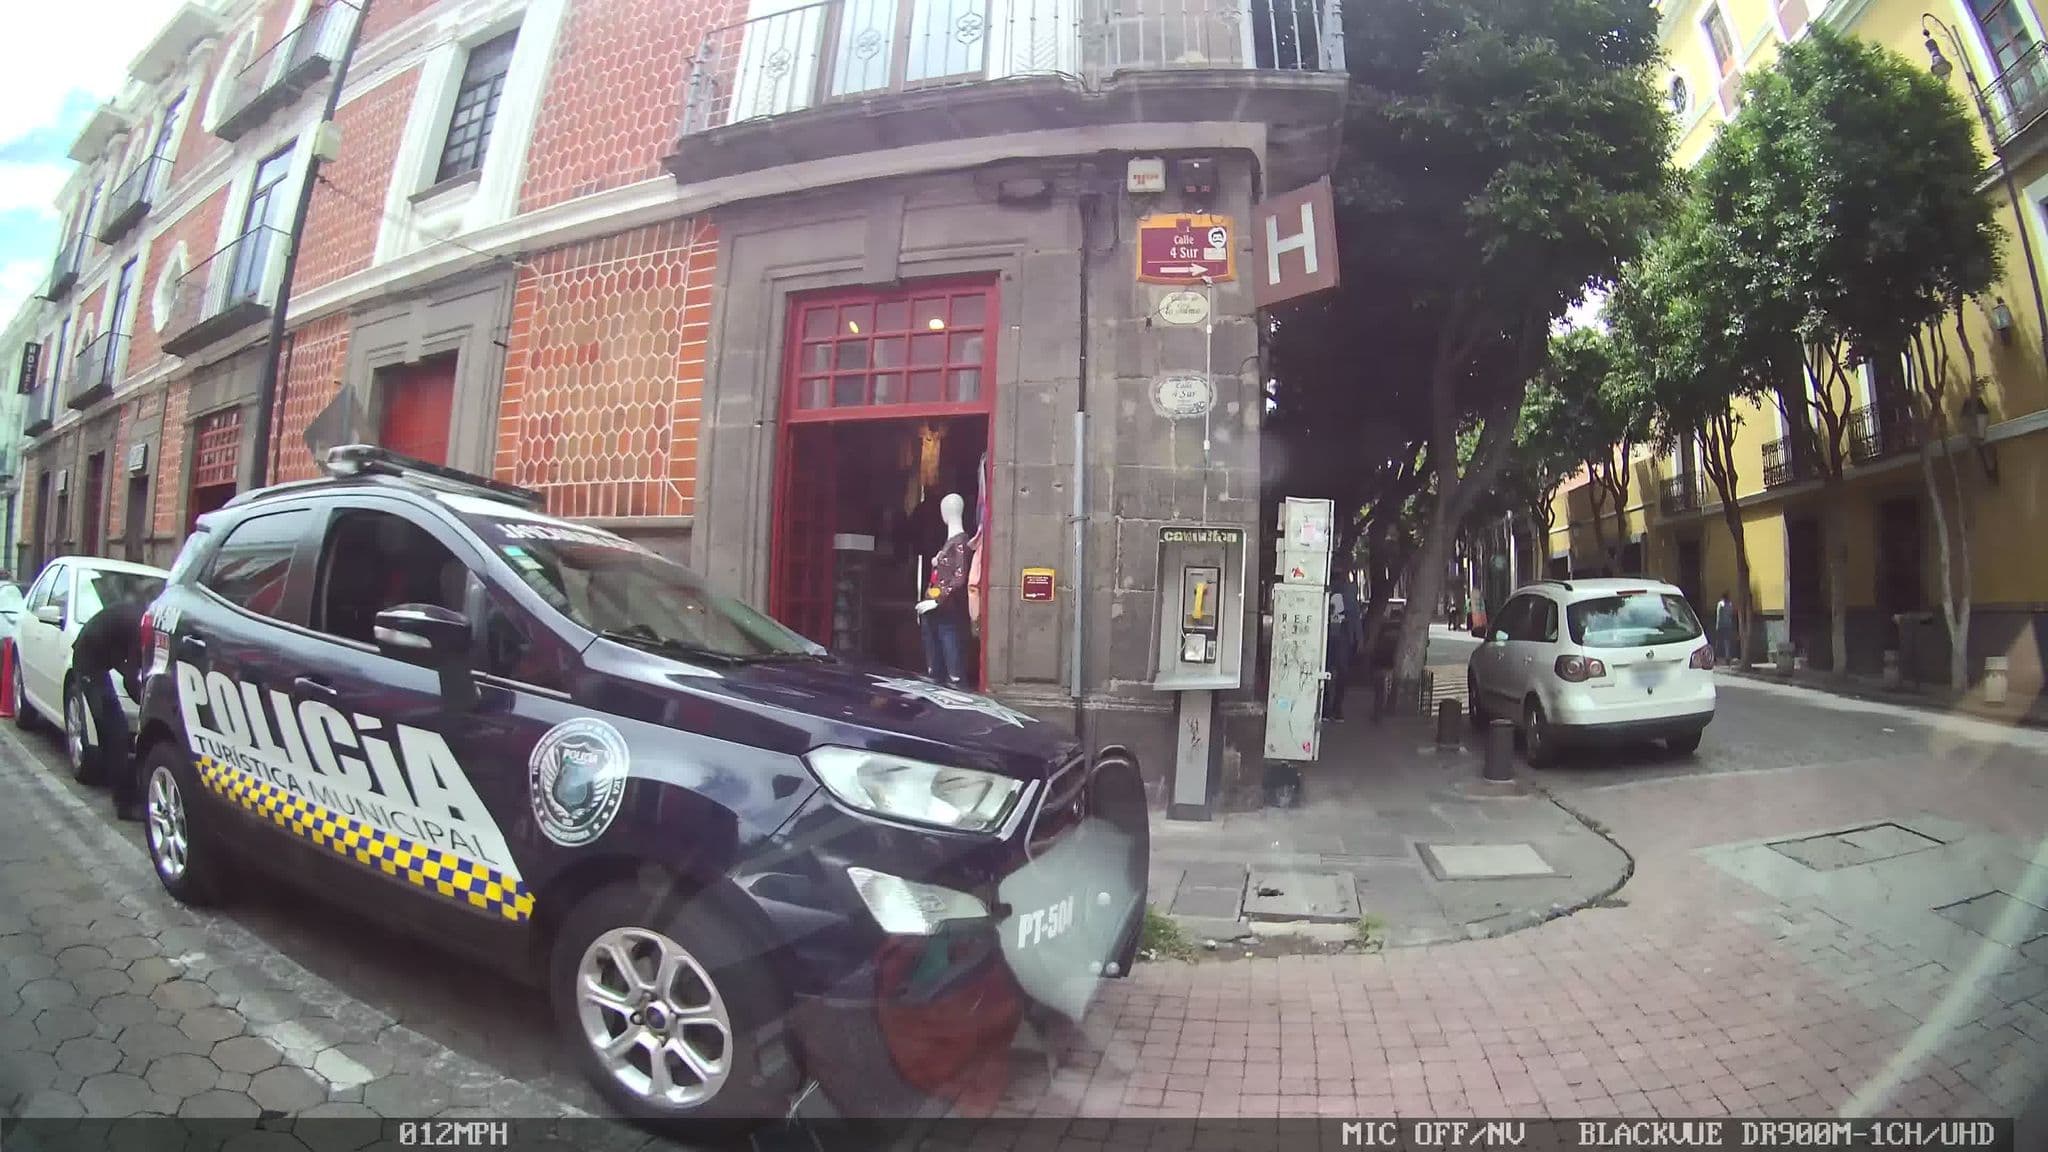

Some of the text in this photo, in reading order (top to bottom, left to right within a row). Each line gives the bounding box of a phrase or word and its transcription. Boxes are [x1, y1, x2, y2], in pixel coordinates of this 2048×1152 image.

[1169, 246, 1199, 259] 4 Sur
[1173, 234, 1195, 245] Calle
[1265, 201, 1318, 286] H
[308, 780, 499, 865] MUNICIPAL
